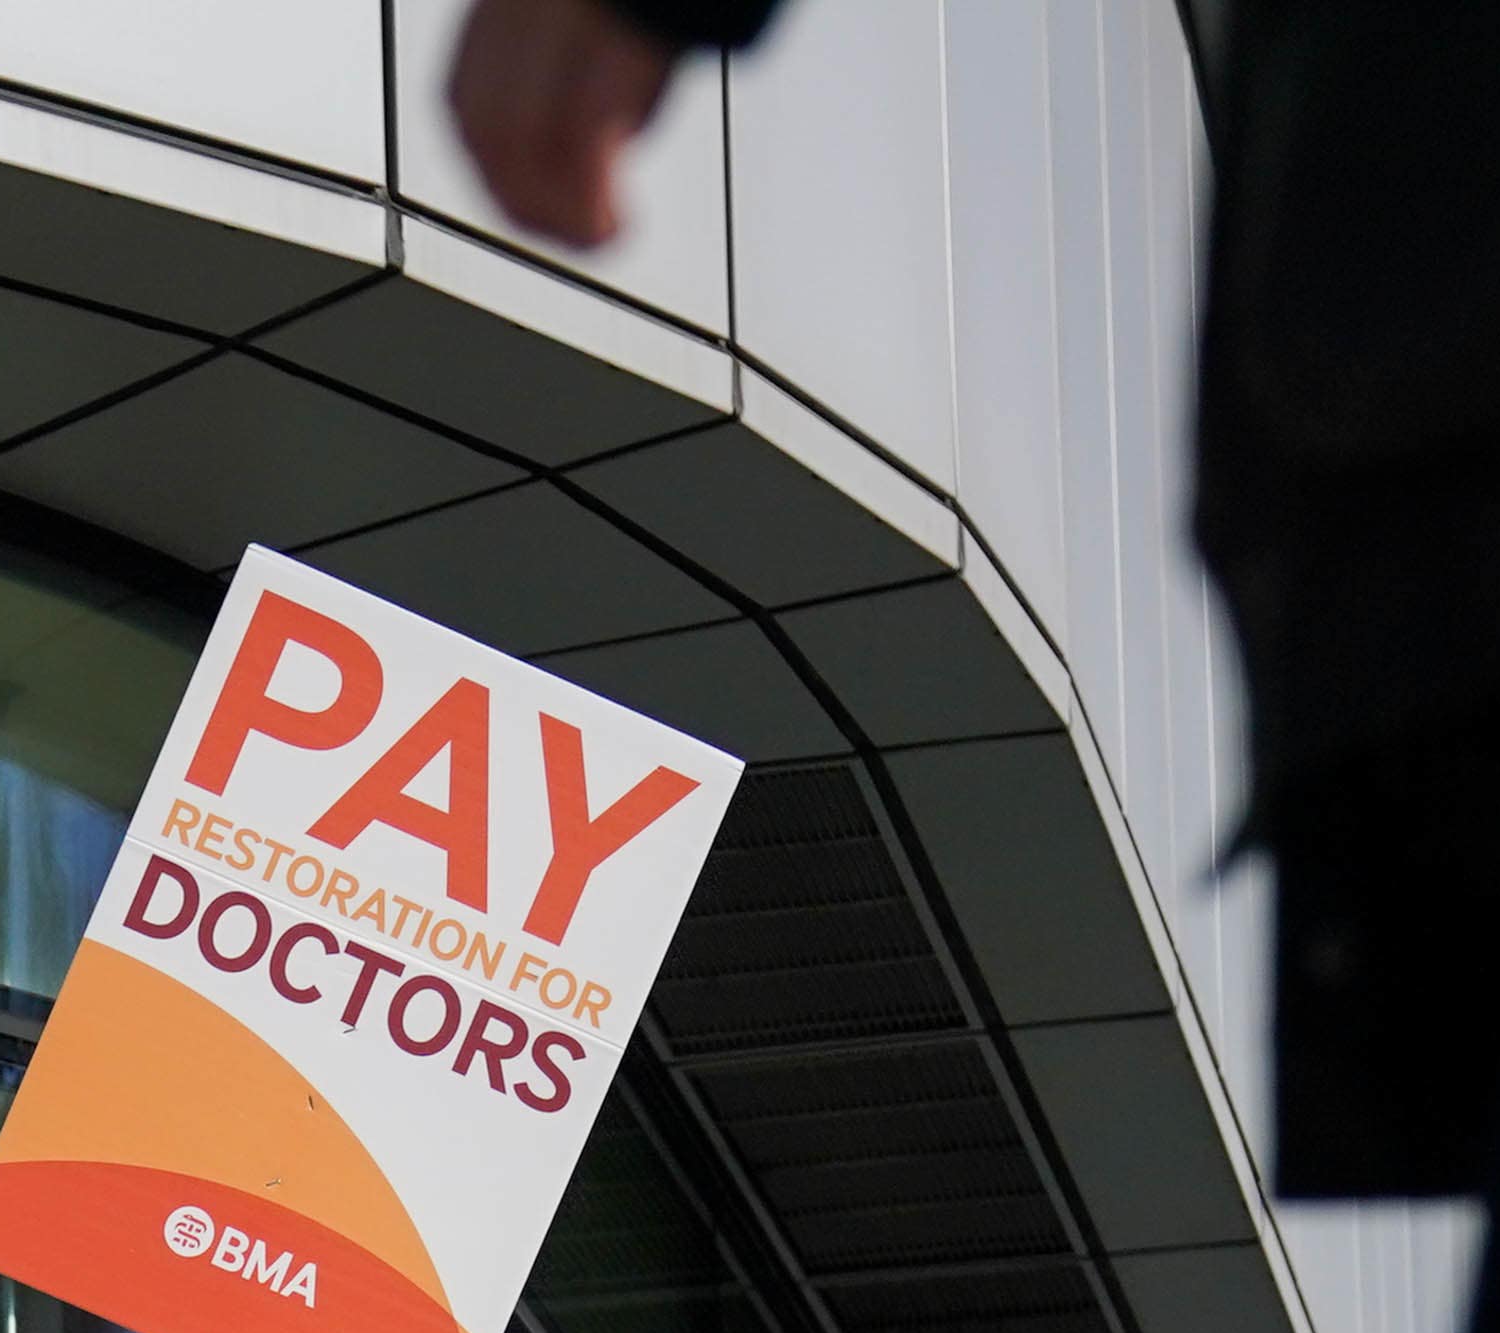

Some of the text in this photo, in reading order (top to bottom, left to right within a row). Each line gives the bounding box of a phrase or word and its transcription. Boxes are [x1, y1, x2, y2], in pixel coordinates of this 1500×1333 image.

[184, 589, 702, 946] PAY
[122, 855, 587, 1114] DOCTORS
[160, 797, 613, 1030] RESTORATION FOR
[211, 1225, 318, 1309] BMA
